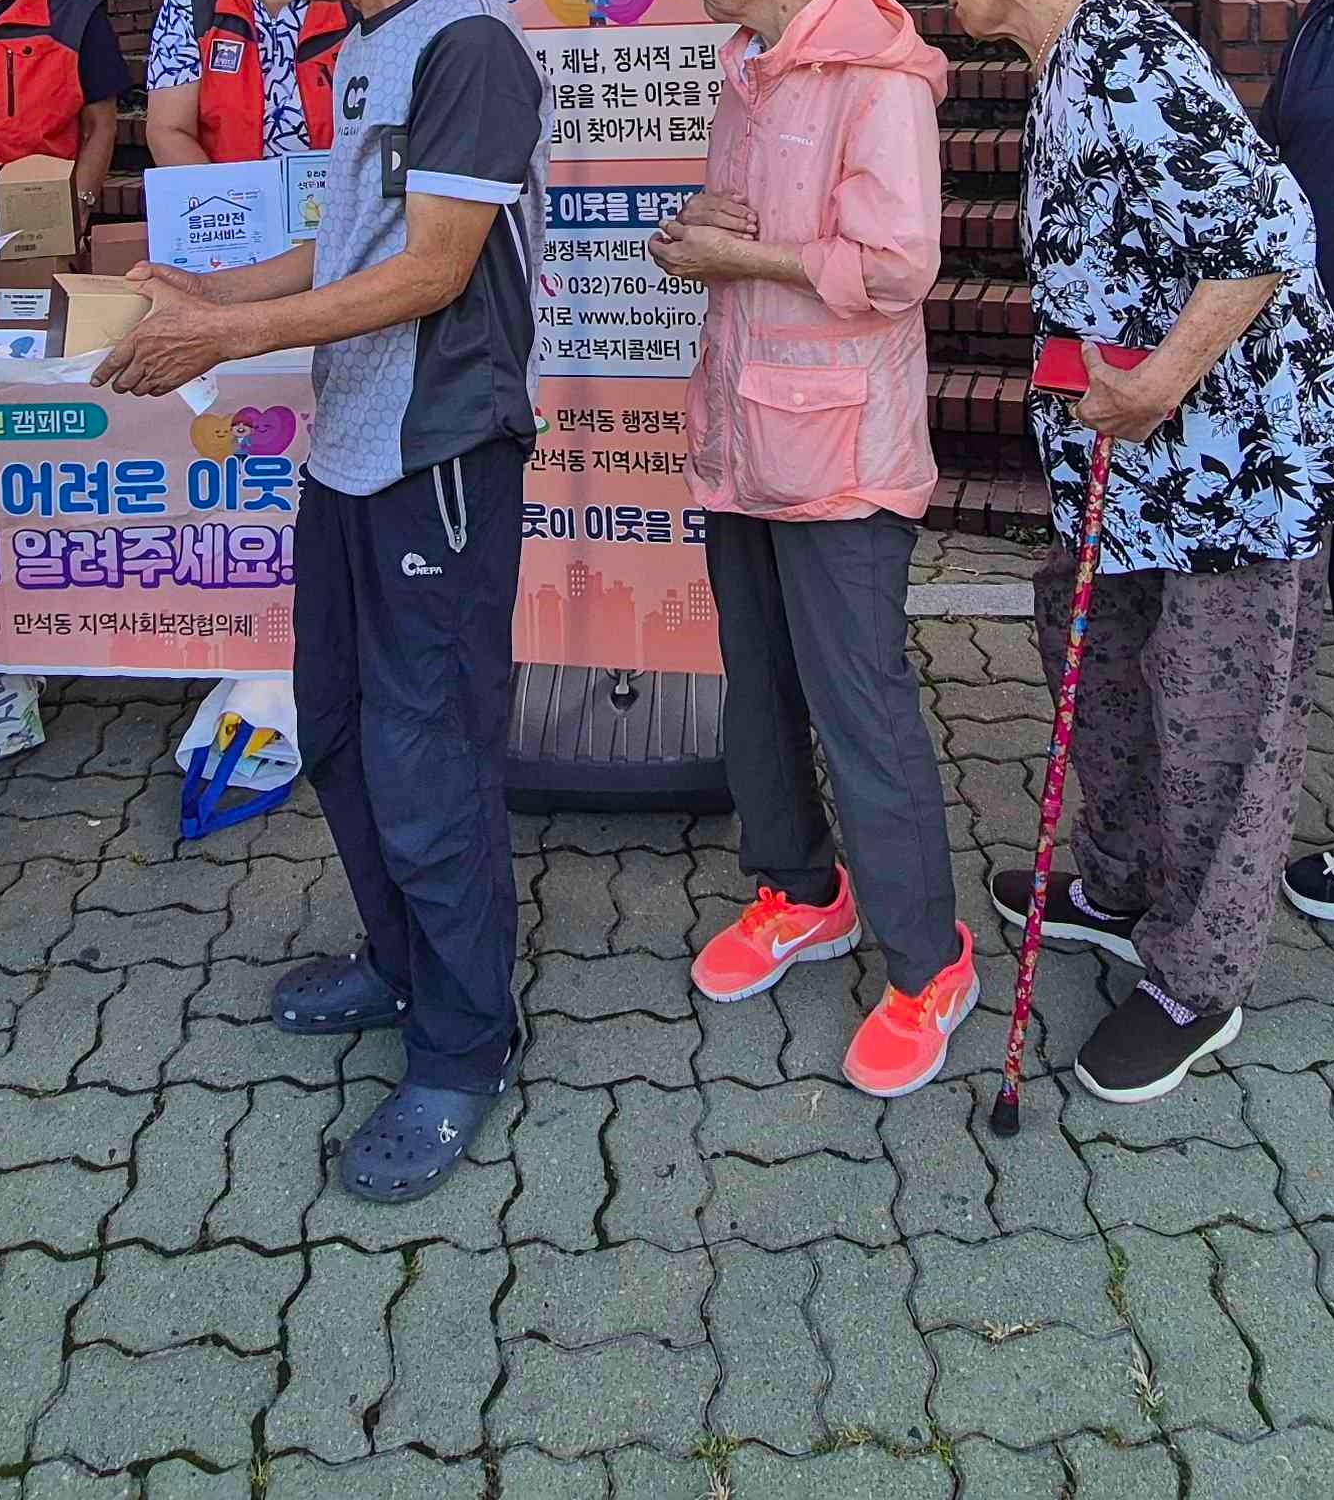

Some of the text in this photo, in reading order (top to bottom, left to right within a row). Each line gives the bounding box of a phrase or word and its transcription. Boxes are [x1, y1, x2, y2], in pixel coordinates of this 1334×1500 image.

[562, 47, 606, 75] 체납,
[614, 46, 671, 72] 정서적
[602, 83, 638, 109] 겪는
[644, 81, 701, 108] 이웃을
[587, 118, 662, 143] 찾아가서
[559, 192, 630, 223] 이웃을
[635, 189, 692, 223] 발견
[188, 212, 246, 230] 응급안전
[189, 230, 247, 244] 안심서비스
[543, 240, 647, 263] 행정복지센터
[567, 276, 704, 299] 032)760-4950
[557, 340, 681, 362] 보건복지콜센터
[10, 409, 87, 435] 캠페인
[556, 409, 616, 433] 만석동
[529, 449, 586, 473] 만석동
[0, 458, 168, 518] 어려운
[584, 506, 673, 544] 이웃을
[13, 523, 296, 590] 알려주세요!
[416, 566, 443, 575] NEPA
[13, 611, 73, 635] 만석동
[78, 612, 253, 637] 지역사회보장협의체
